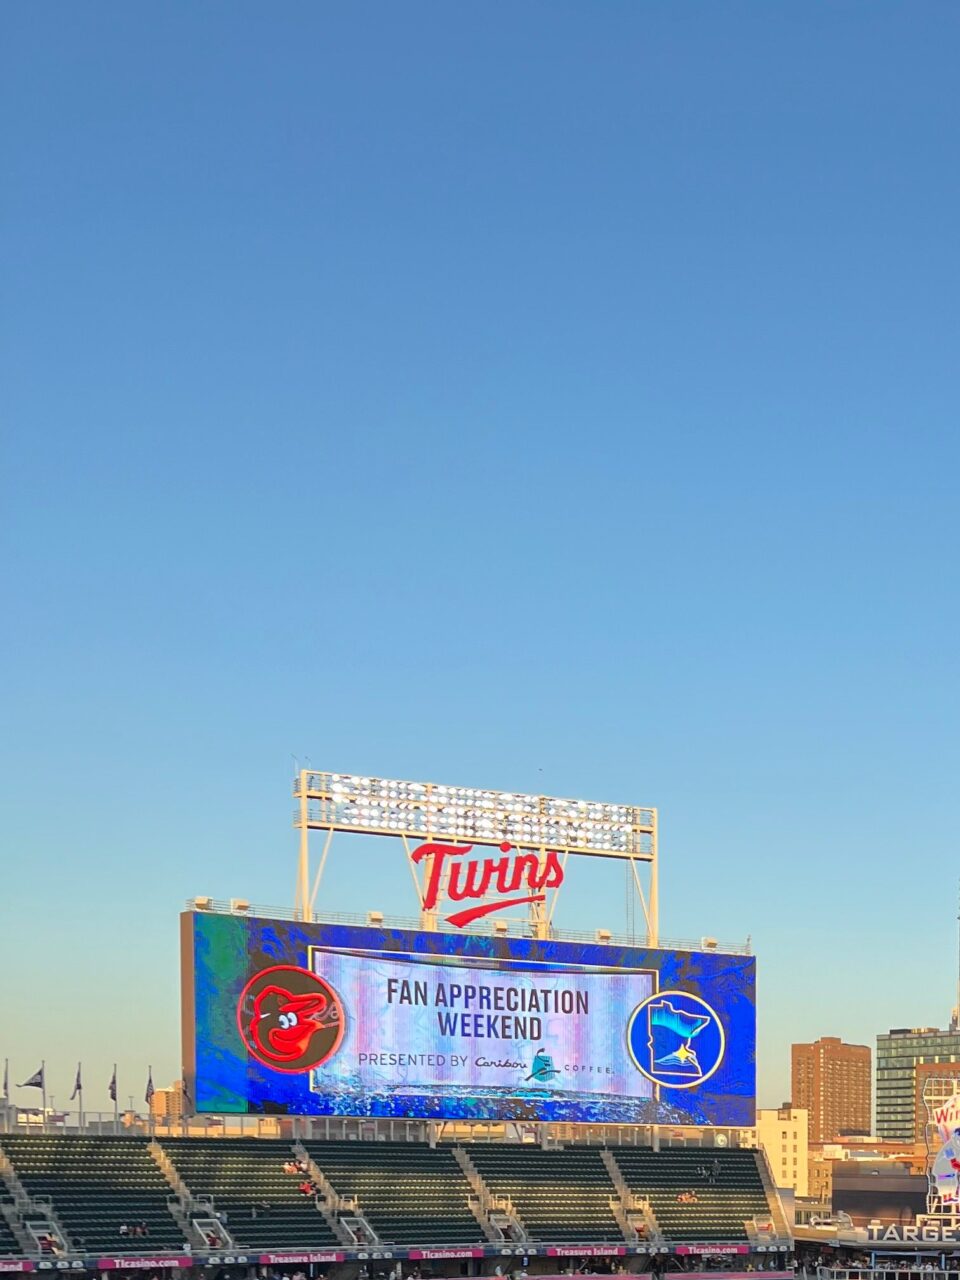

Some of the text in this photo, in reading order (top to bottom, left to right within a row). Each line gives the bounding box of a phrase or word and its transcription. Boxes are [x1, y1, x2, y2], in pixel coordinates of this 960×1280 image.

[411, 841, 564, 911] Twins
[387, 978, 589, 1015] FAN APPRECIATION
[437, 1011, 542, 1041] WEEKEND
[358, 1053, 446, 1067] PRESENTED
[450, 1055, 469, 1067] BY
[474, 1056, 528, 1070] Caribou
[269, 1253, 337, 1264] Treasure Island
[556, 1247, 619, 1256] Treasure Island
